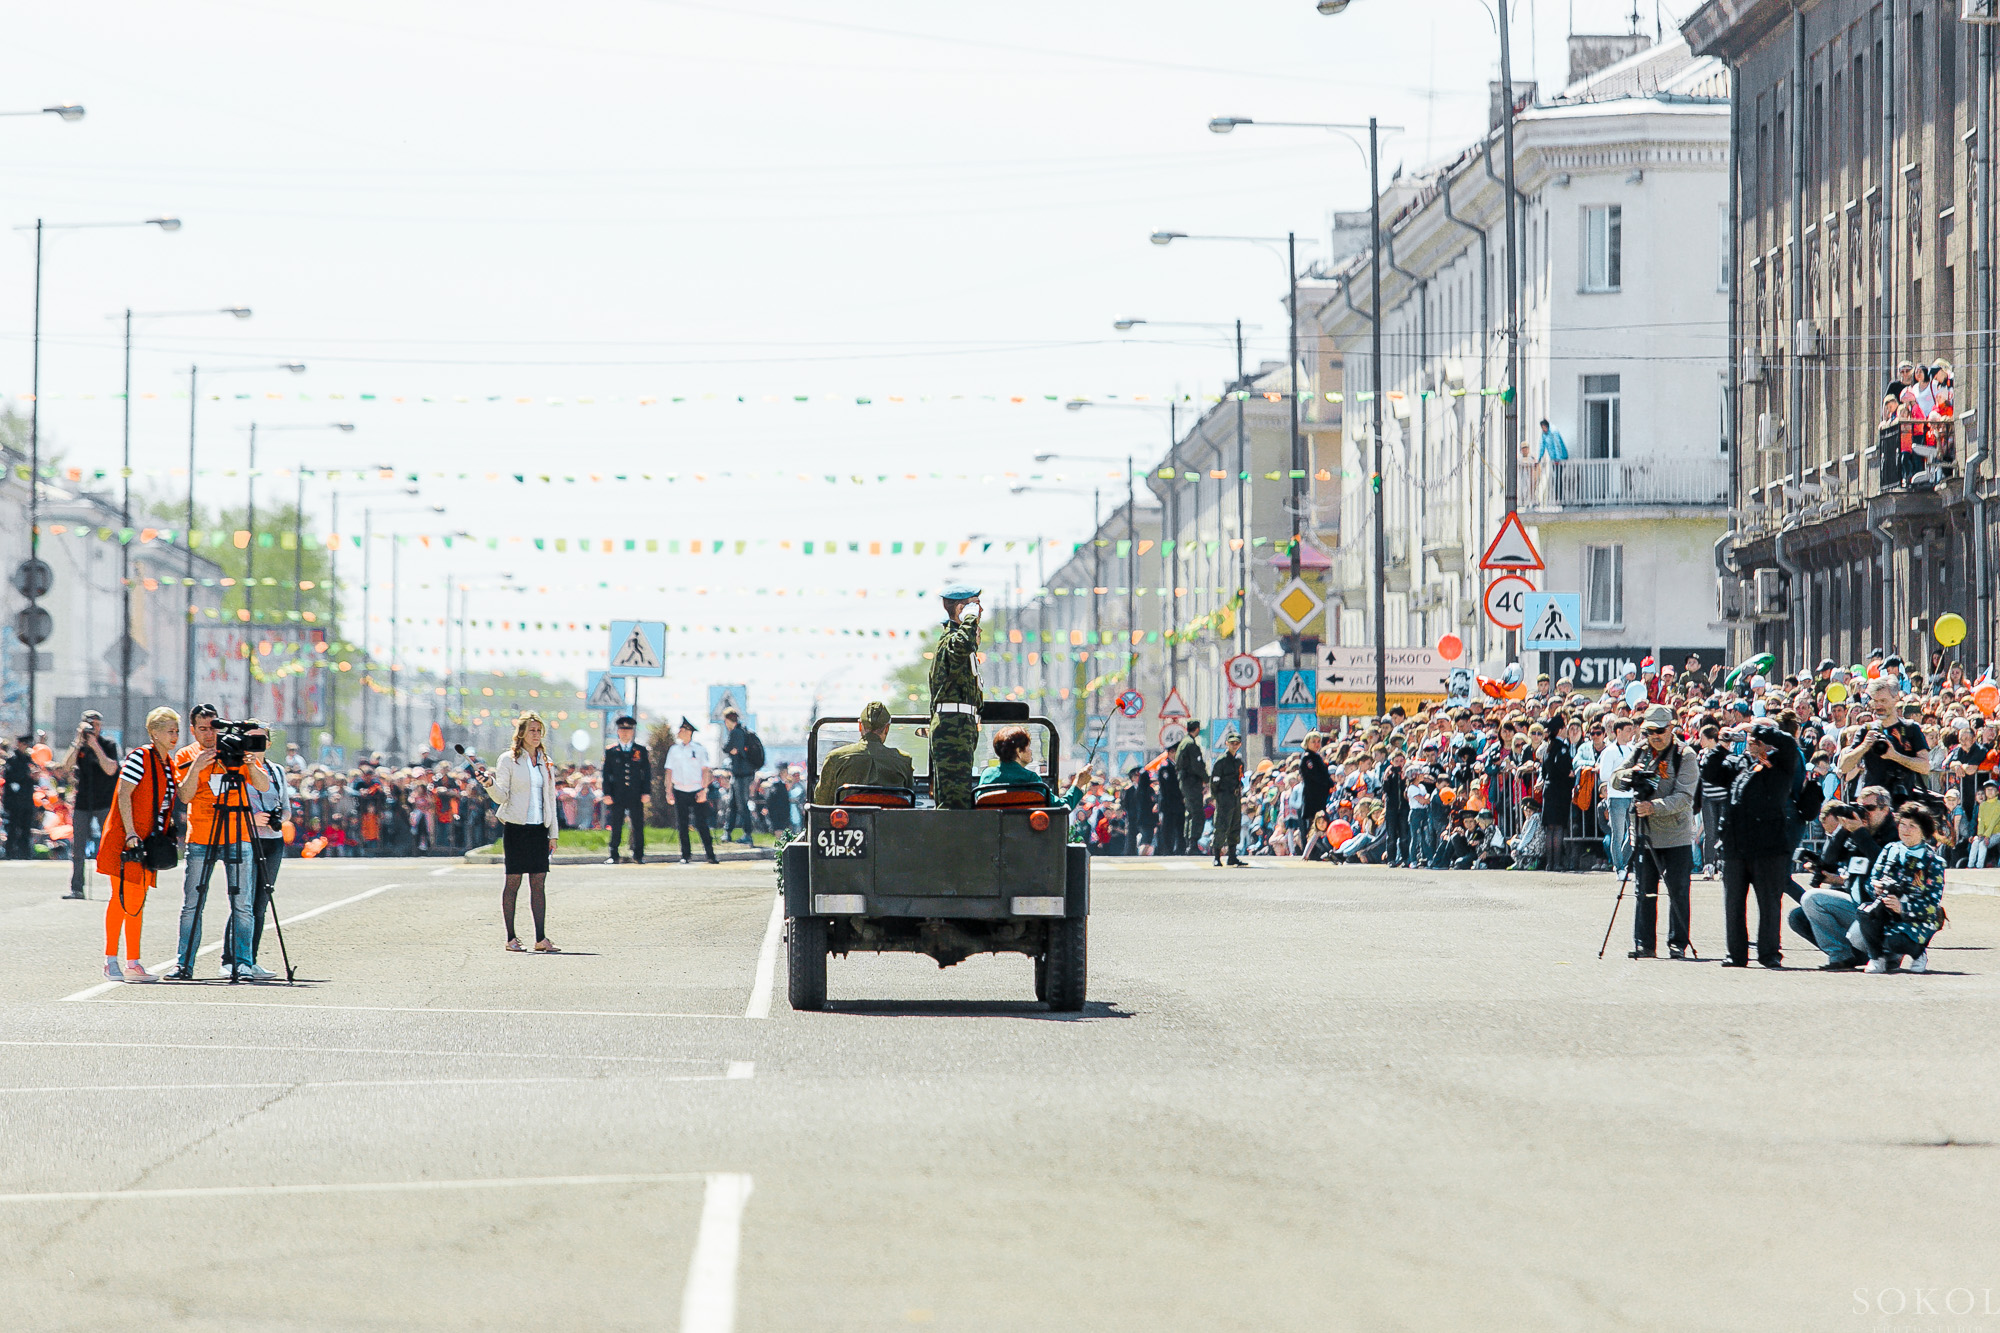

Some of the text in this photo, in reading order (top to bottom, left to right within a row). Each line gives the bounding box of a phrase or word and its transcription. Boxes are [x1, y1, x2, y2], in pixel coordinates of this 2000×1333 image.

[1496, 591, 1523, 612] 40
[1234, 663, 1254, 679] 50
[1165, 730, 1185, 742] 40
[825, 845, 857, 857] ИРК
